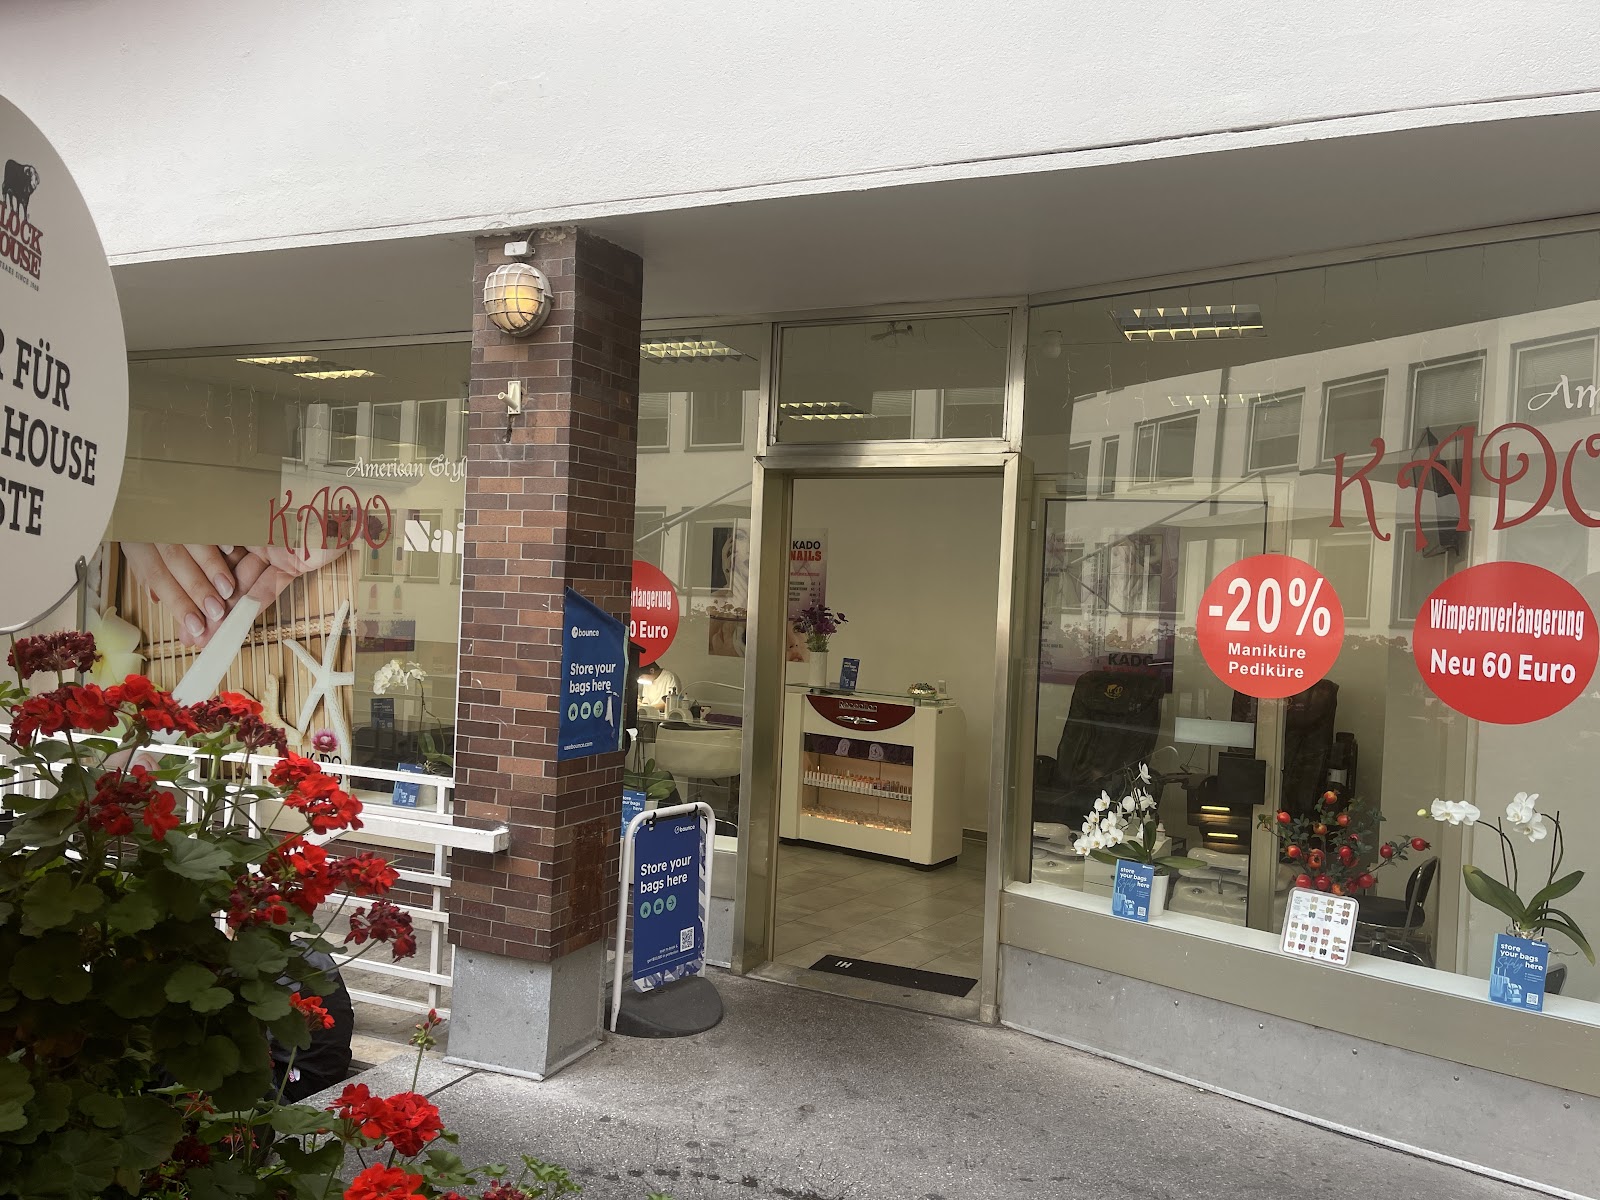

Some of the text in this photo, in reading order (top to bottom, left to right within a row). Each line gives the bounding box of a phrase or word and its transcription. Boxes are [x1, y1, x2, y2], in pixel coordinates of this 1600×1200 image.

[12, 337, 71, 412] FÜR
[1, 404, 98, 486] HOUSE
[346, 456, 424, 478] American
[268, 486, 392, 561] KADO
[792, 540, 821, 550] KADO
[790, 550, 822, 562] NAILS
[1208, 577, 1331, 637] -20%
[1430, 598, 1585, 641] Wimpernverlängerung
[578, 628, 600, 637] bounce
[639, 620, 669, 639] Euro
[1228, 642, 1307, 659] Maniküre
[570, 662, 617, 678] Store your
[1228, 661, 1305, 679] Pediküre
[1430, 648, 1576, 684] Neu 60 Euro
[569, 678, 612, 696] bags here
[679, 825, 696, 833] bounce
[640, 855, 692, 877] Store your
[640, 873, 688, 894] bags here
[1133, 874, 1147, 882] bags
[1500, 943, 1521, 952] store
[1500, 949, 1539, 963] your bags
[1525, 961, 1544, 971] here
